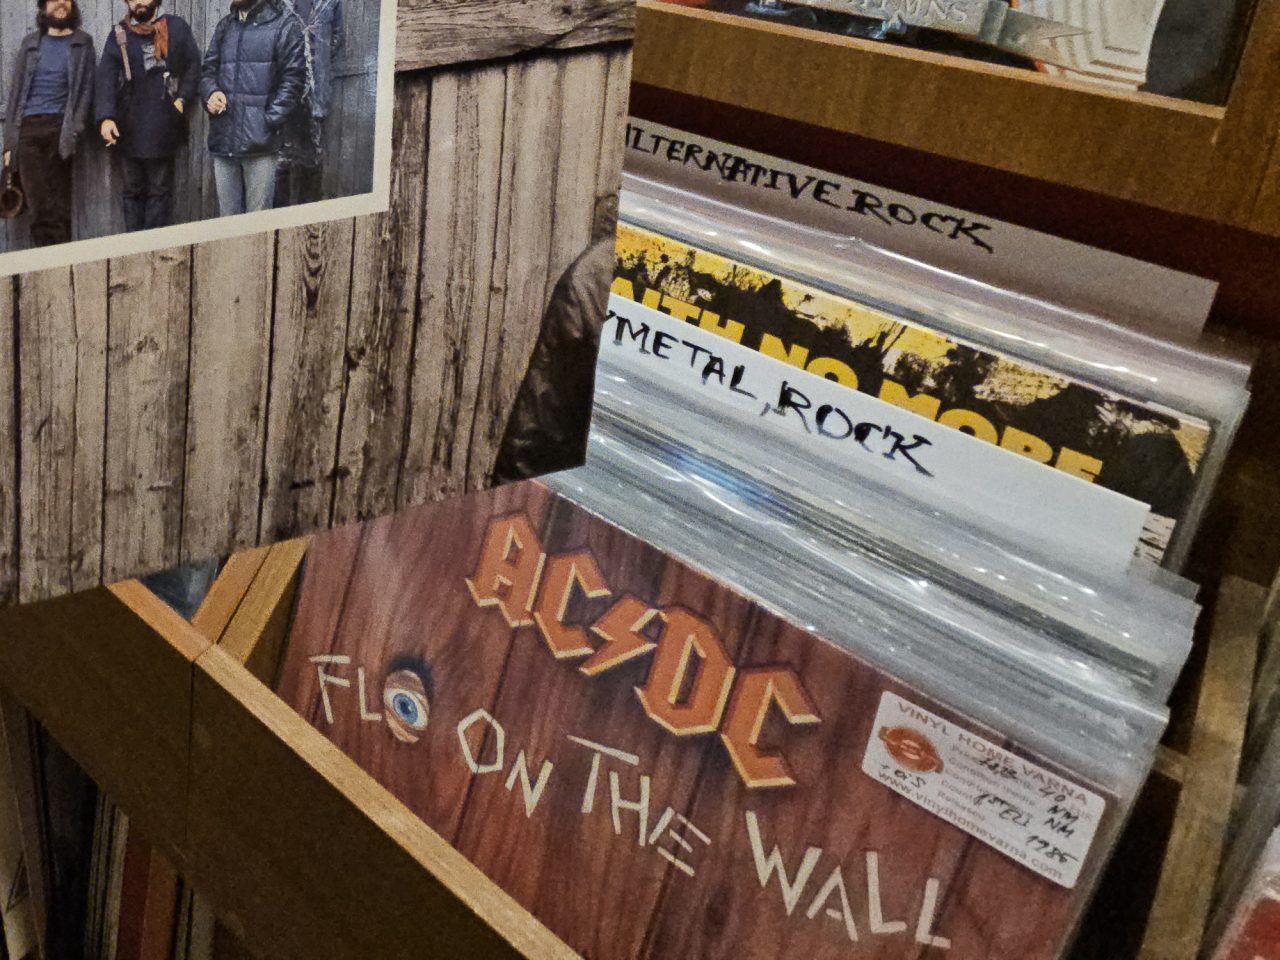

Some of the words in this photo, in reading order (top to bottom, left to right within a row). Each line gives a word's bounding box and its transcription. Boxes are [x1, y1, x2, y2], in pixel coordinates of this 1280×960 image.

[625, 123, 841, 210] LTERNATIVE
[846, 188, 994, 254] ROCK
[897, 701, 950, 736] VINYL
[956, 732, 1015, 768] HOME
[1021, 764, 1089, 805] VARNA
[457, 707, 554, 818] ON
[567, 734, 712, 877] THE
[744, 810, 952, 950] WALL
[877, 772, 1064, 882] www.vinylhomevarna.com
